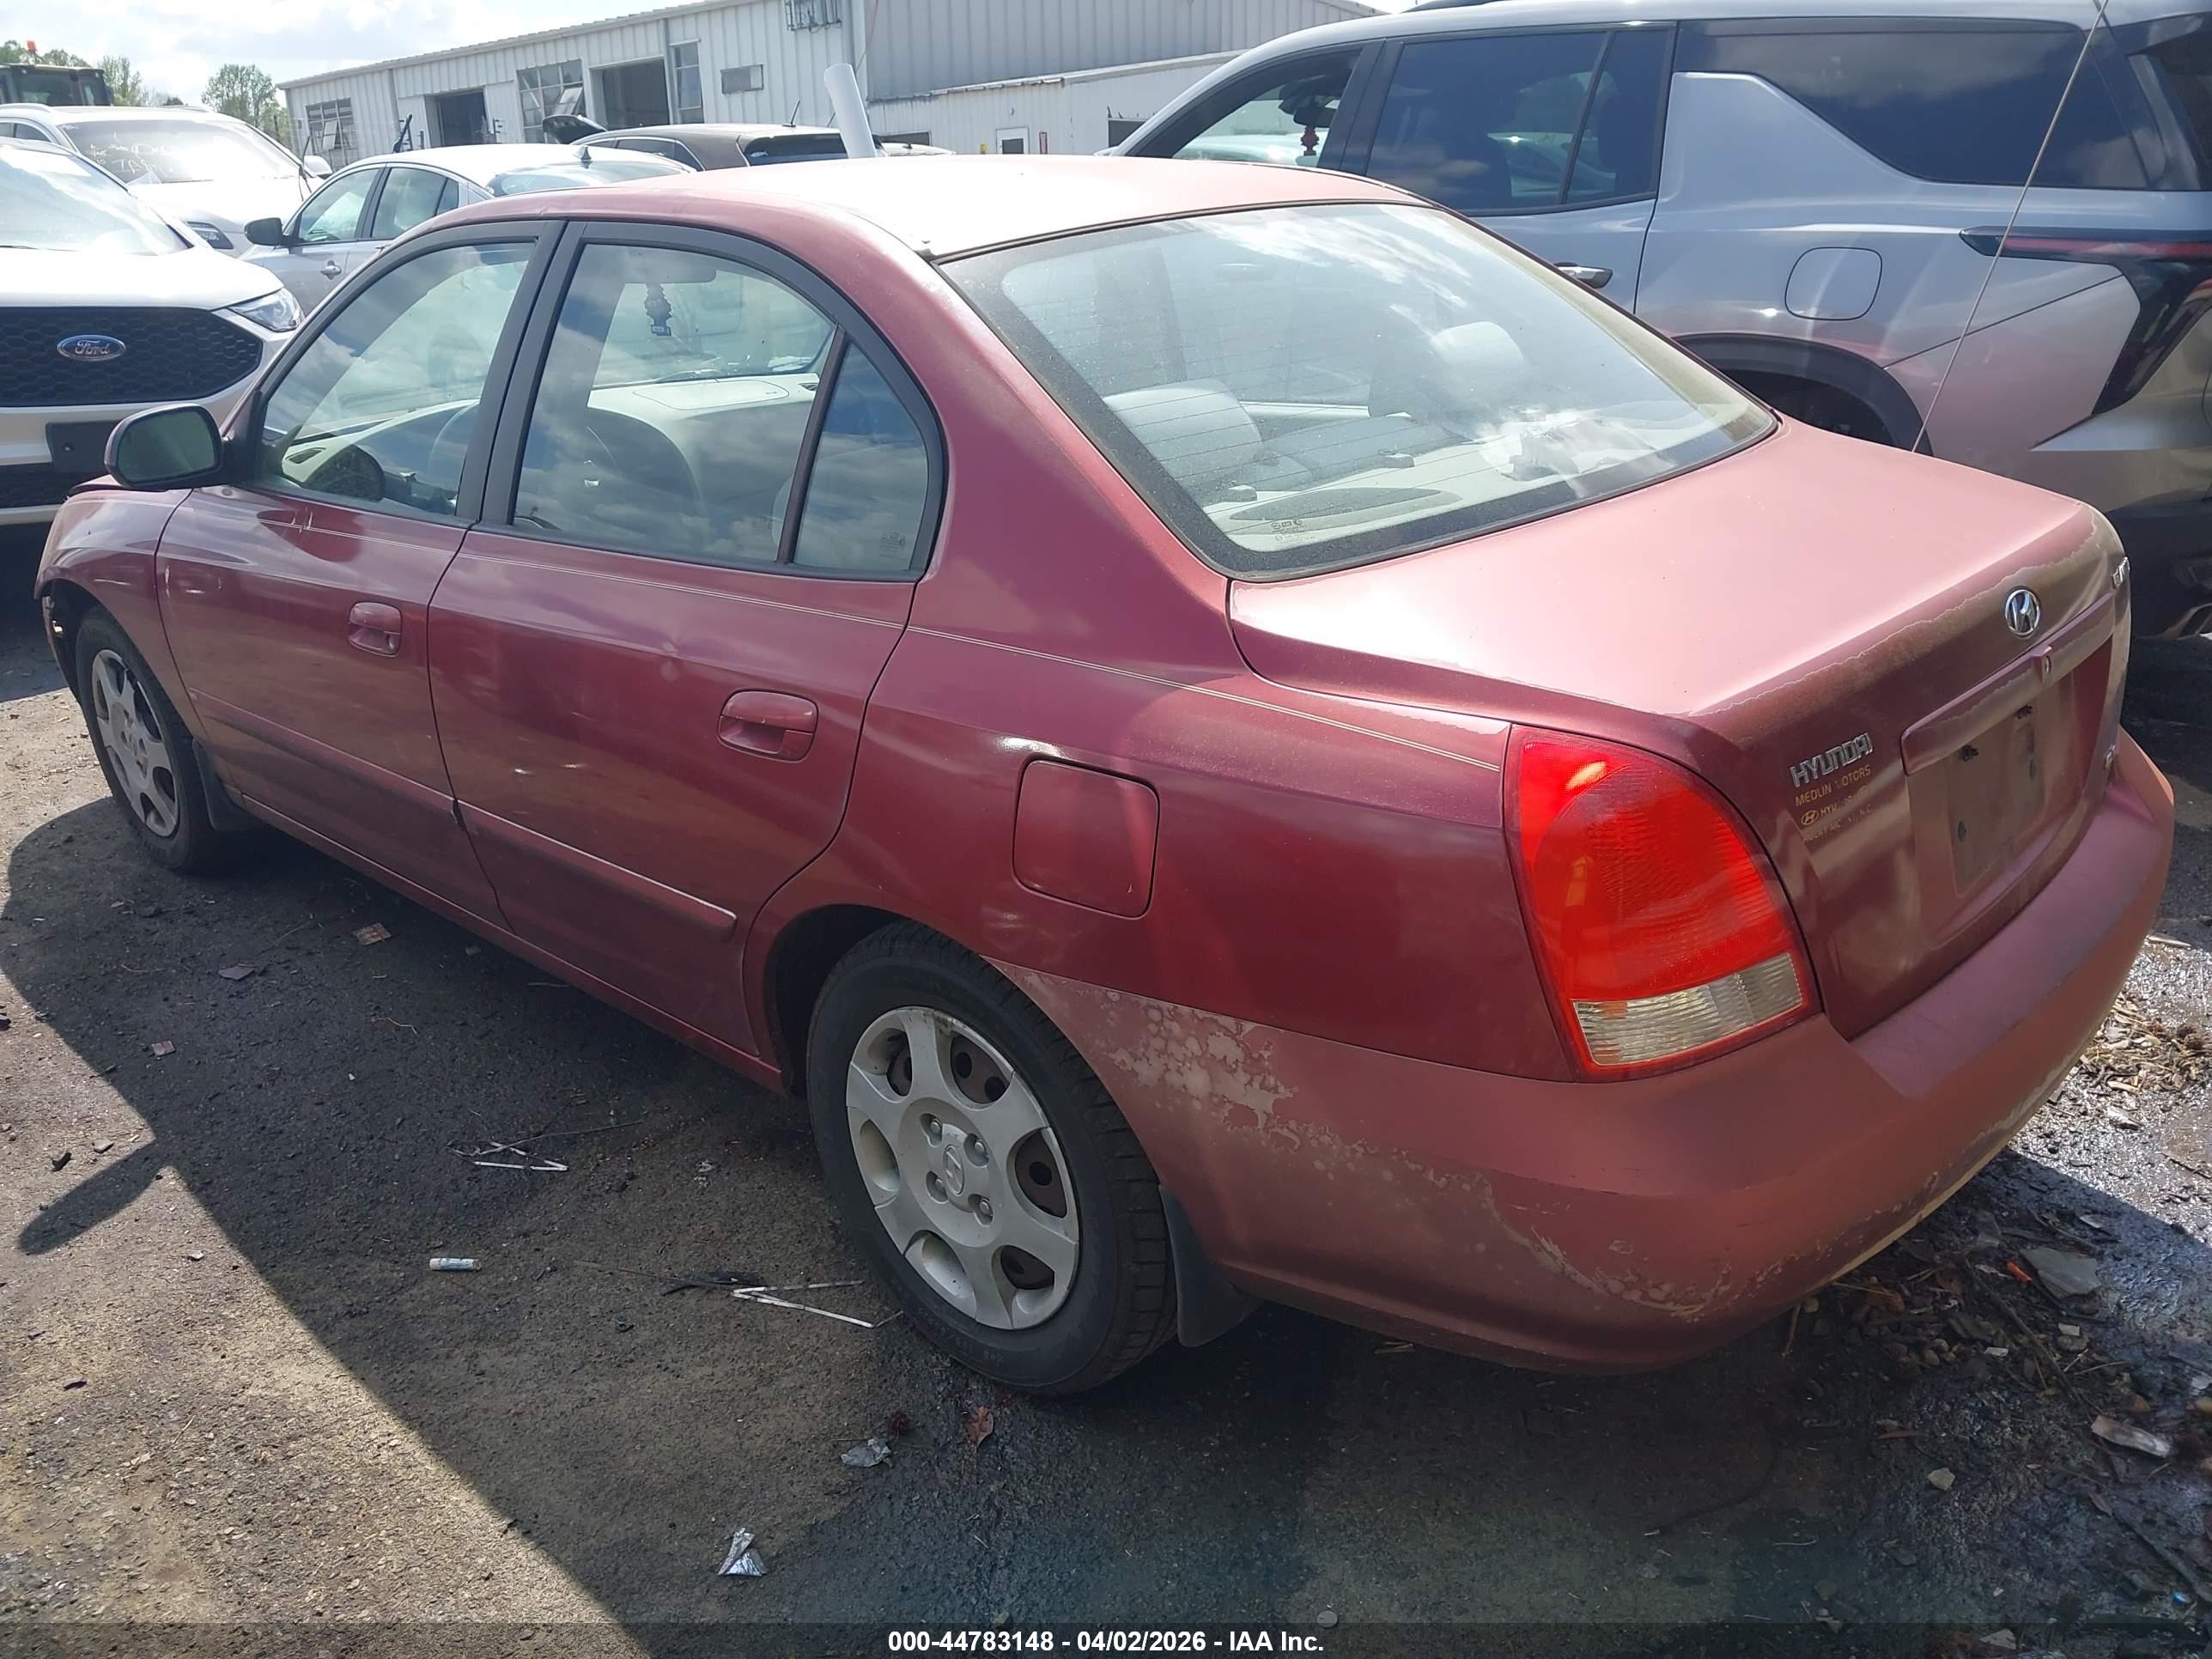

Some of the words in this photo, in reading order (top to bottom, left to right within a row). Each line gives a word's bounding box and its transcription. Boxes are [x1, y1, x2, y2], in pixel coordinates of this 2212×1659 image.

[75, 339, 110, 355] Ford
[1790, 732, 1873, 787] HYUNDAI
[1795, 782, 1832, 806] MEDLIN
